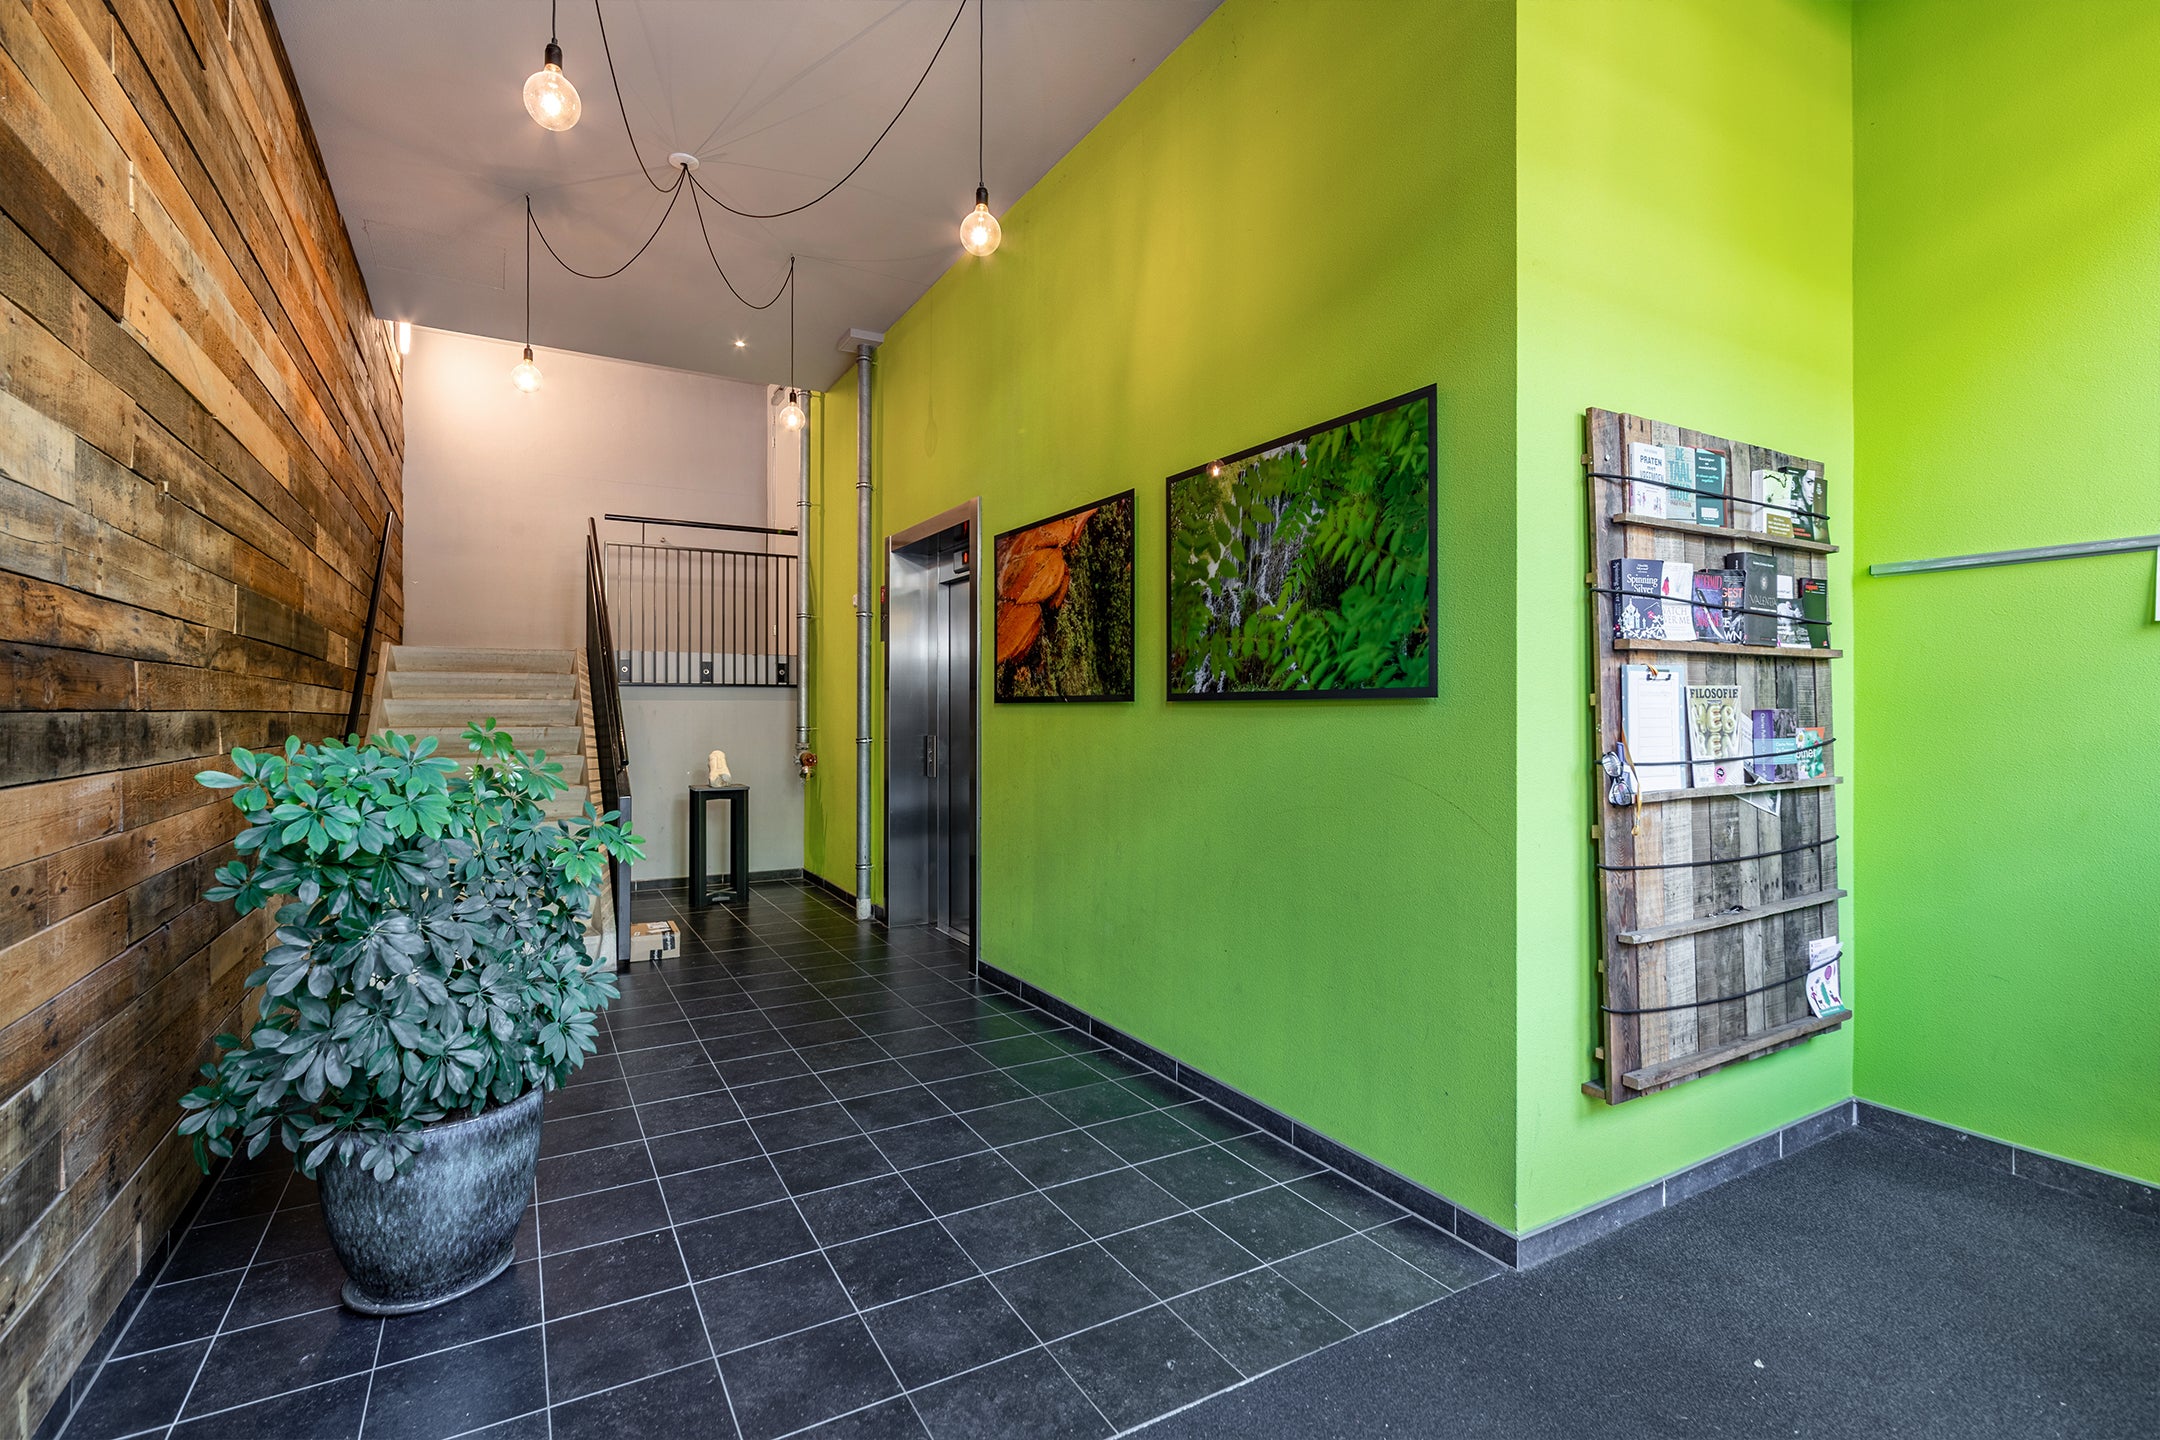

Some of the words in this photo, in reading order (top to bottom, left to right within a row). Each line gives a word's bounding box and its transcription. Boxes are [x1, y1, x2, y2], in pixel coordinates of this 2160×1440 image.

[1639, 454, 1663, 467] PRATEN
[1626, 573, 1659, 588] Spinning
[1633, 583, 1654, 594] Silver
[1689, 688, 1738, 699] FILOSOFIE
